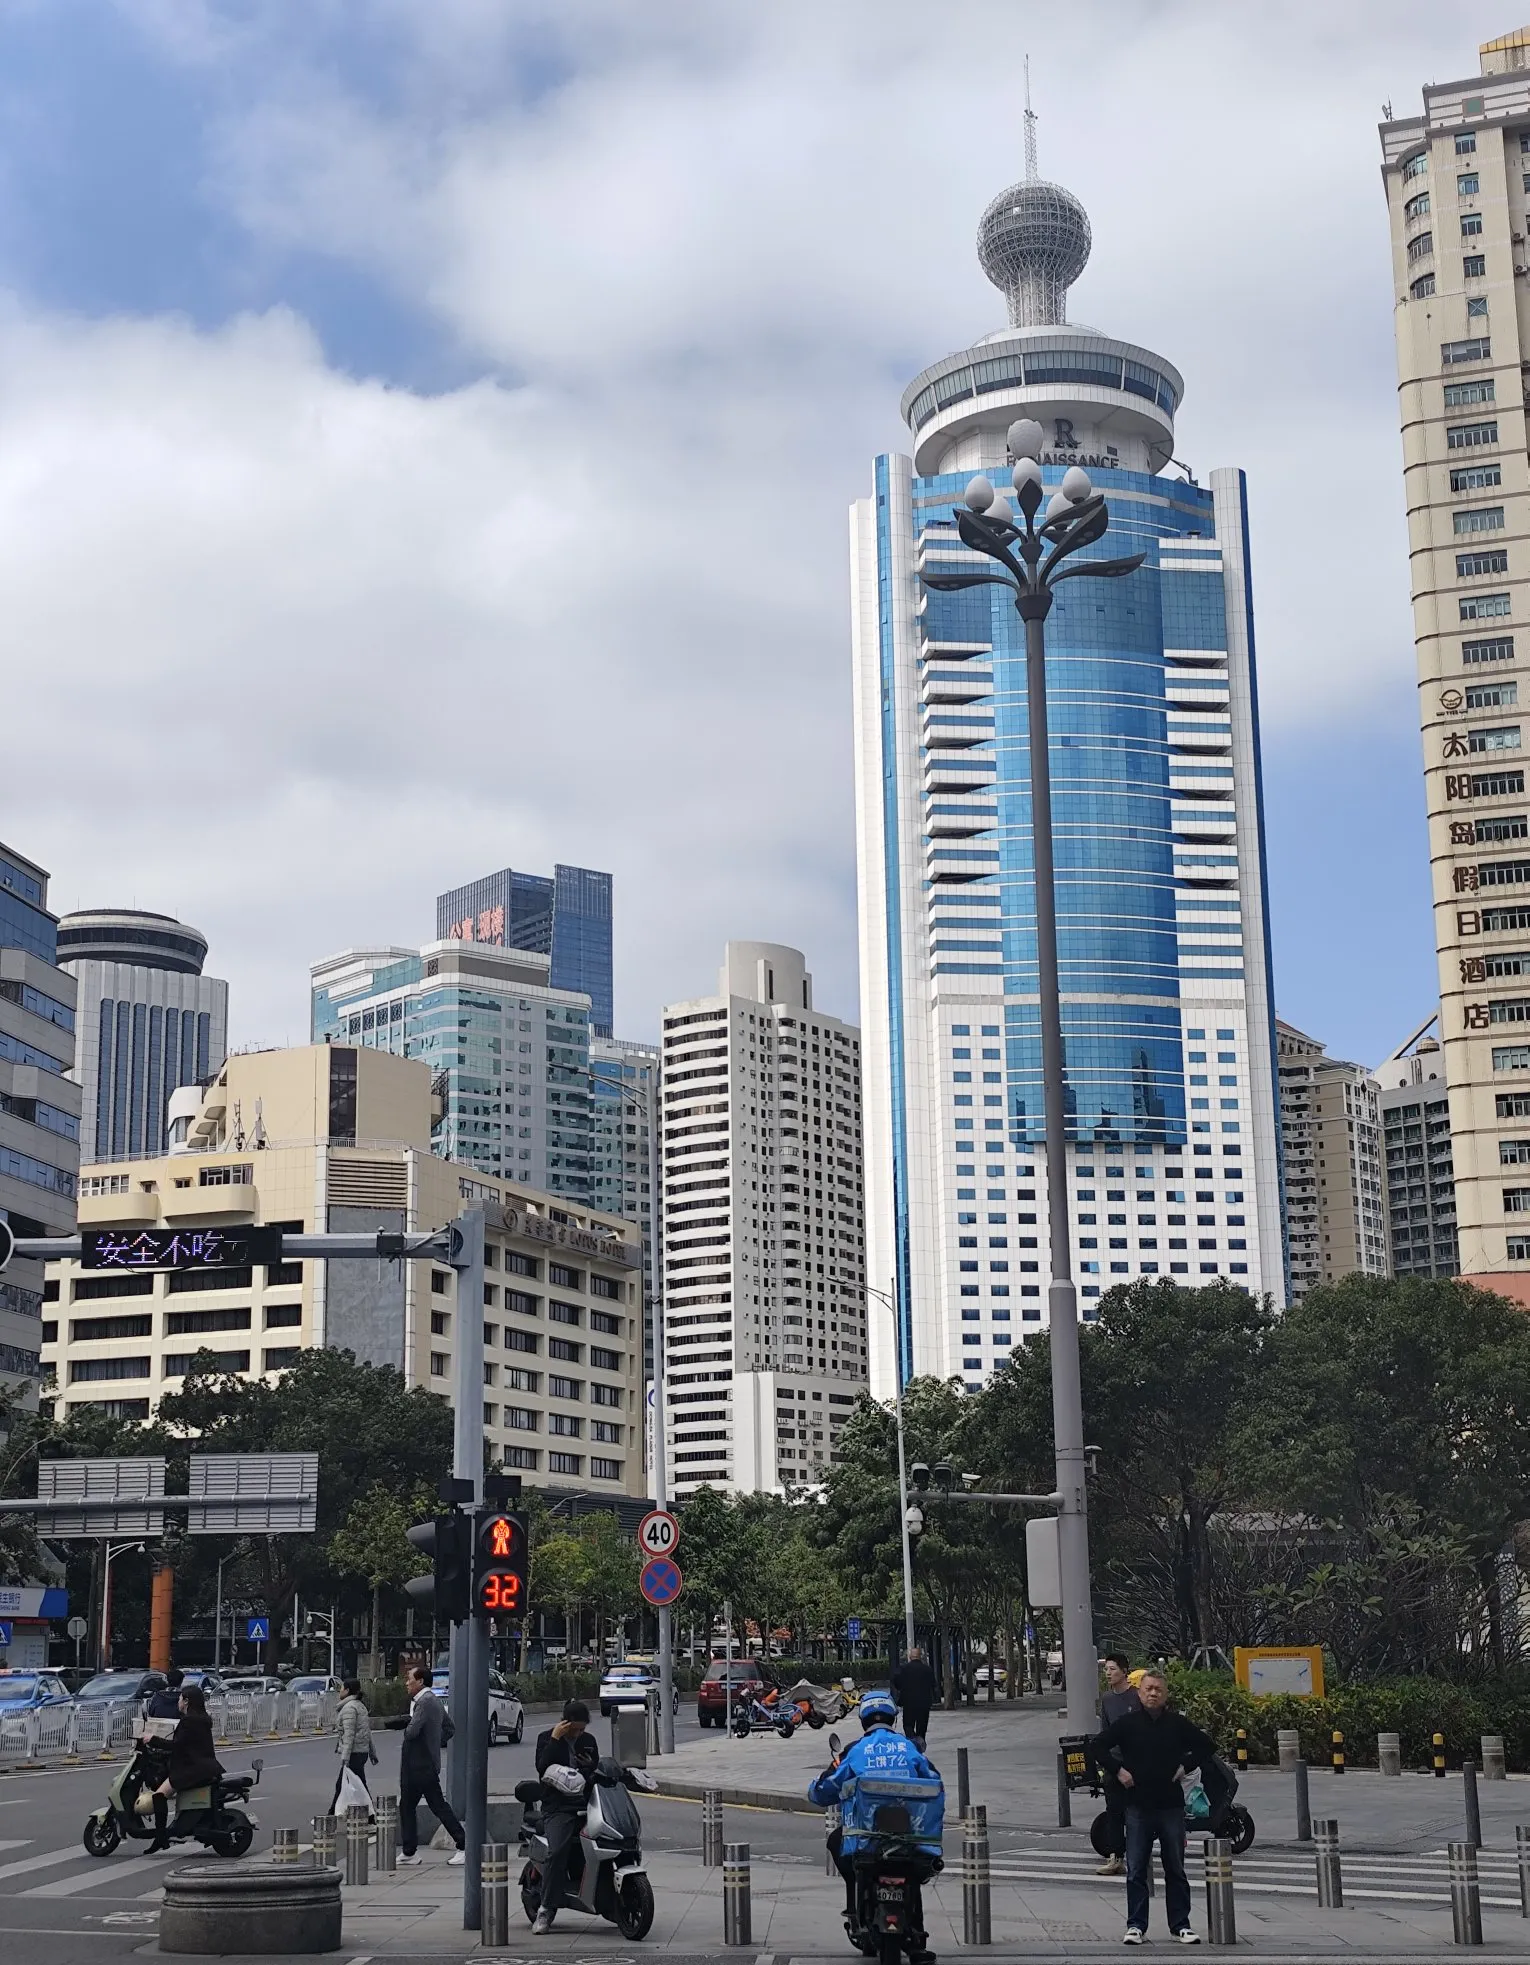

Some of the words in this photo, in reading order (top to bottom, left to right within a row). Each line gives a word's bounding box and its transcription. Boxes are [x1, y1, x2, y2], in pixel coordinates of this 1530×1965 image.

[1007, 453, 1119, 470] RAISSANCE
[1442, 731, 1489, 1029] 太阳岛假日酒店
[647, 1522, 671, 1545] 40
[484, 1575, 518, 1608] 32
[864, 1742, 907, 1755] 点个外卖
[864, 1755, 908, 1769] 上饿了么
